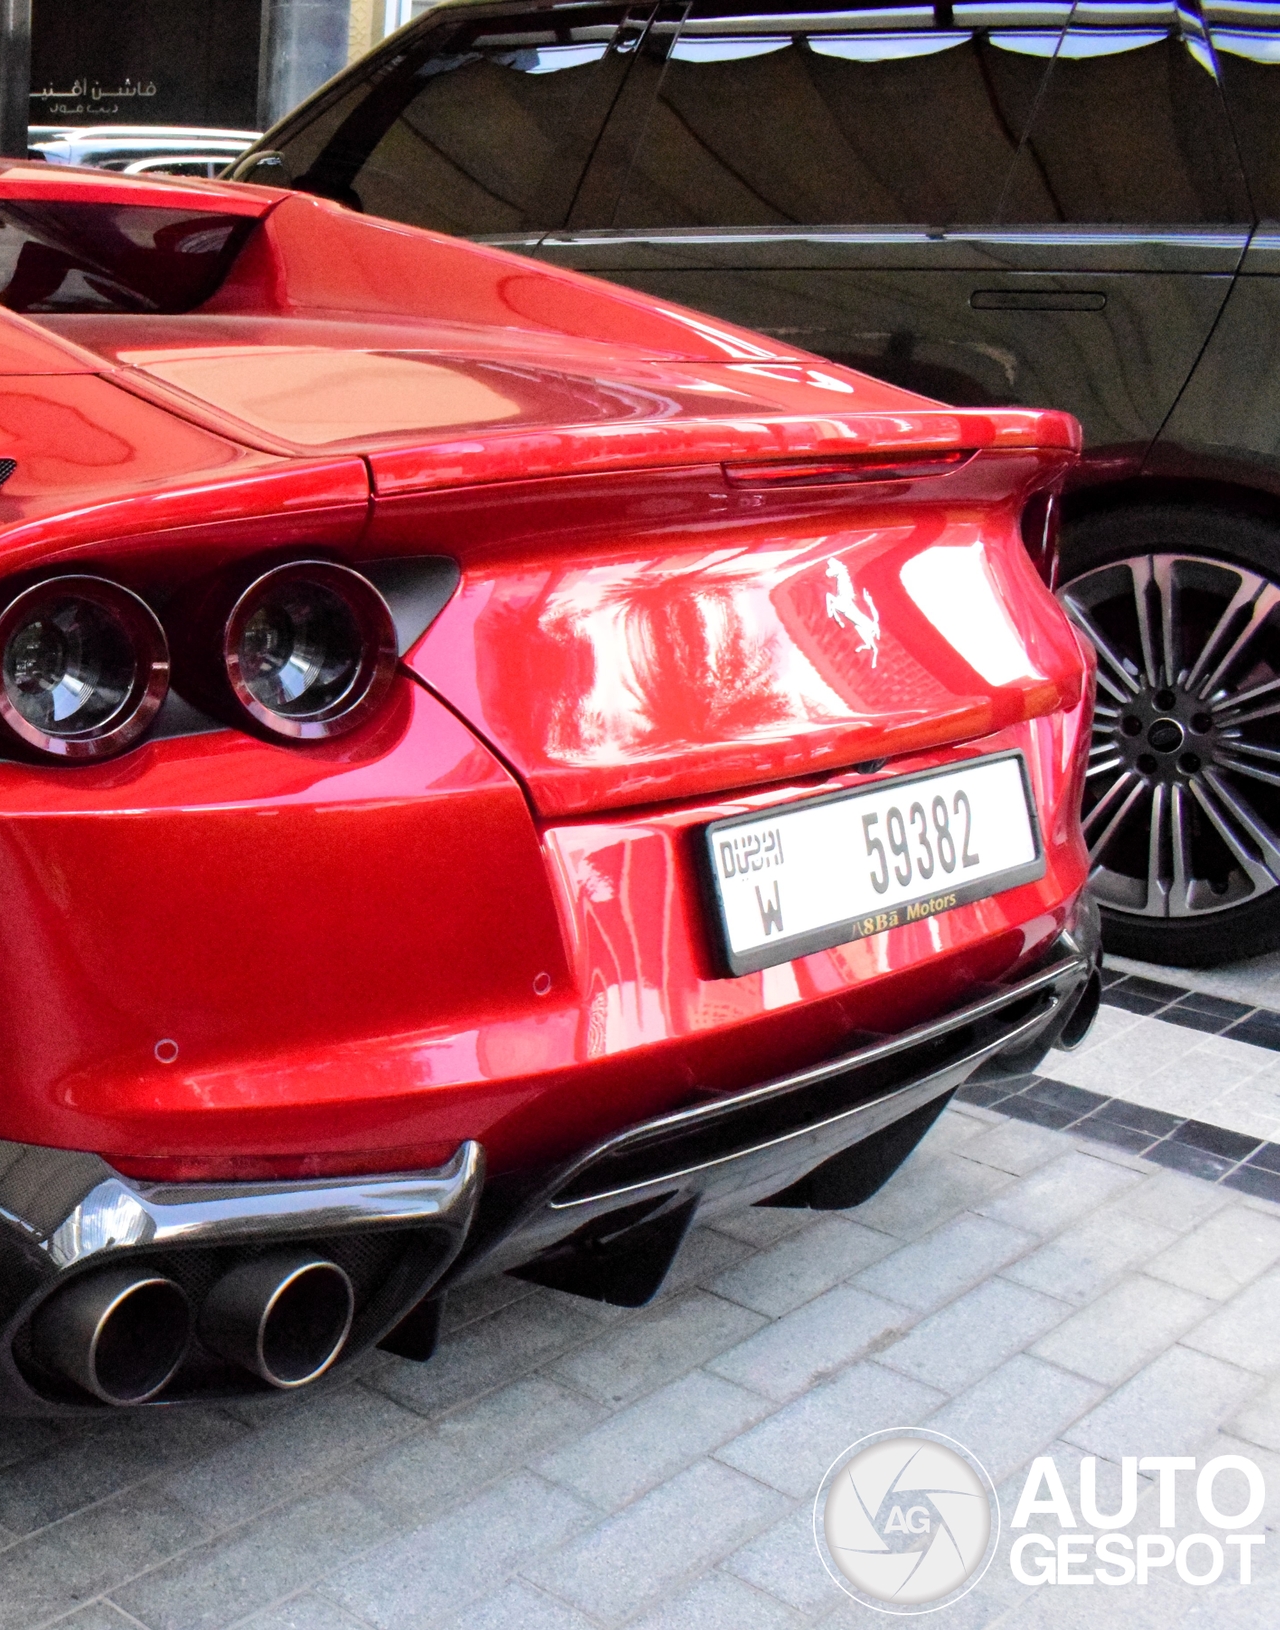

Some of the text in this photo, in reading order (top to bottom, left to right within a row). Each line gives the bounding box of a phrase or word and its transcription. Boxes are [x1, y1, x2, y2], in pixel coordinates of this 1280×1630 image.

[861, 789, 980, 894] 59382
[754, 880, 784, 936] W
[907, 893, 957, 921] Motors
